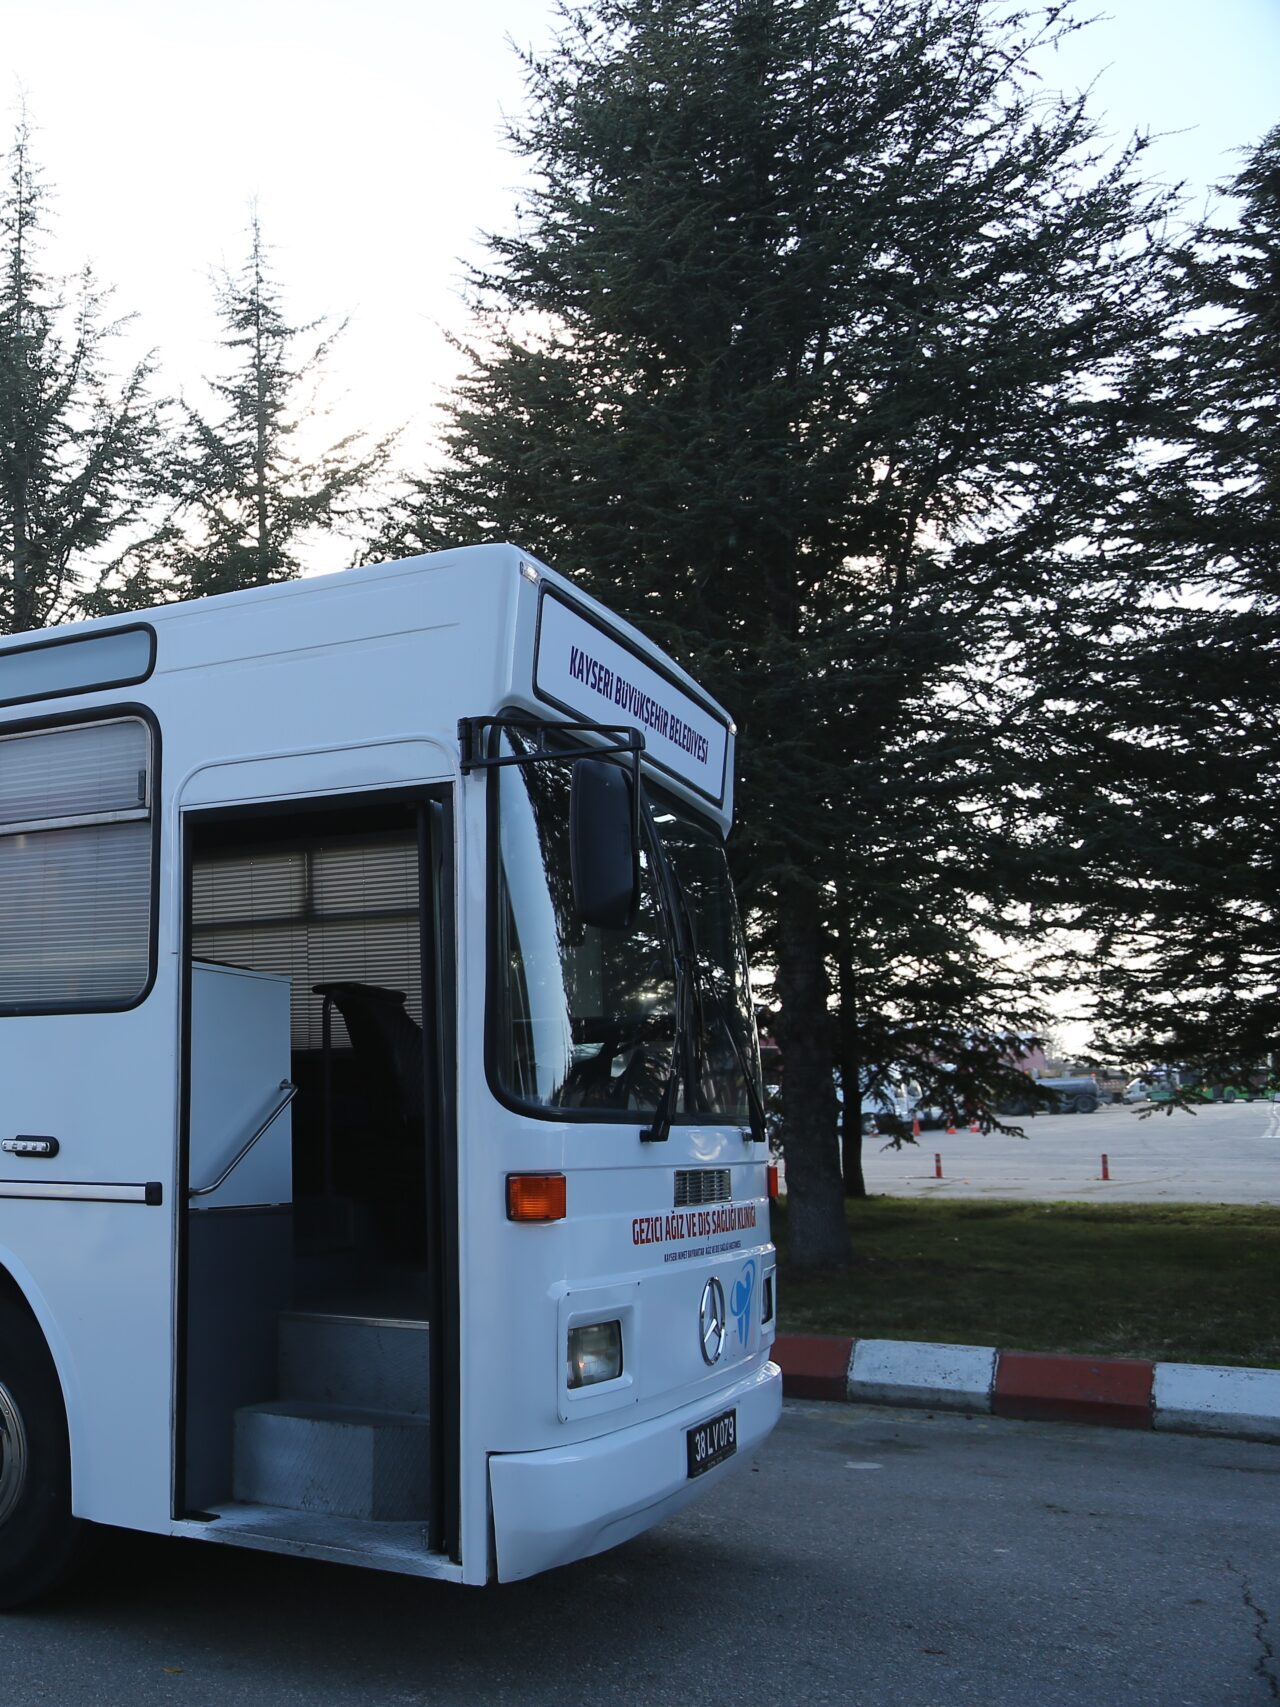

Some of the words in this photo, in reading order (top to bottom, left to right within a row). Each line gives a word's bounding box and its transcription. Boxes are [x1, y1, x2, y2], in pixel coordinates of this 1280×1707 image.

[569, 646, 614, 700] KAYSERİ
[615, 675, 669, 740] BÜYÜKŞEHİR
[669, 714, 709, 765] BELEDİYESİ
[632, 1216, 663, 1245] GEZİCİ
[665, 1210, 685, 1241] AĞIZ
[685, 1213, 697, 1238] VE
[698, 1211, 711, 1240] DİŞ
[695, 1430, 706, 1461] 38
[720, 1416, 734, 1447] 079
